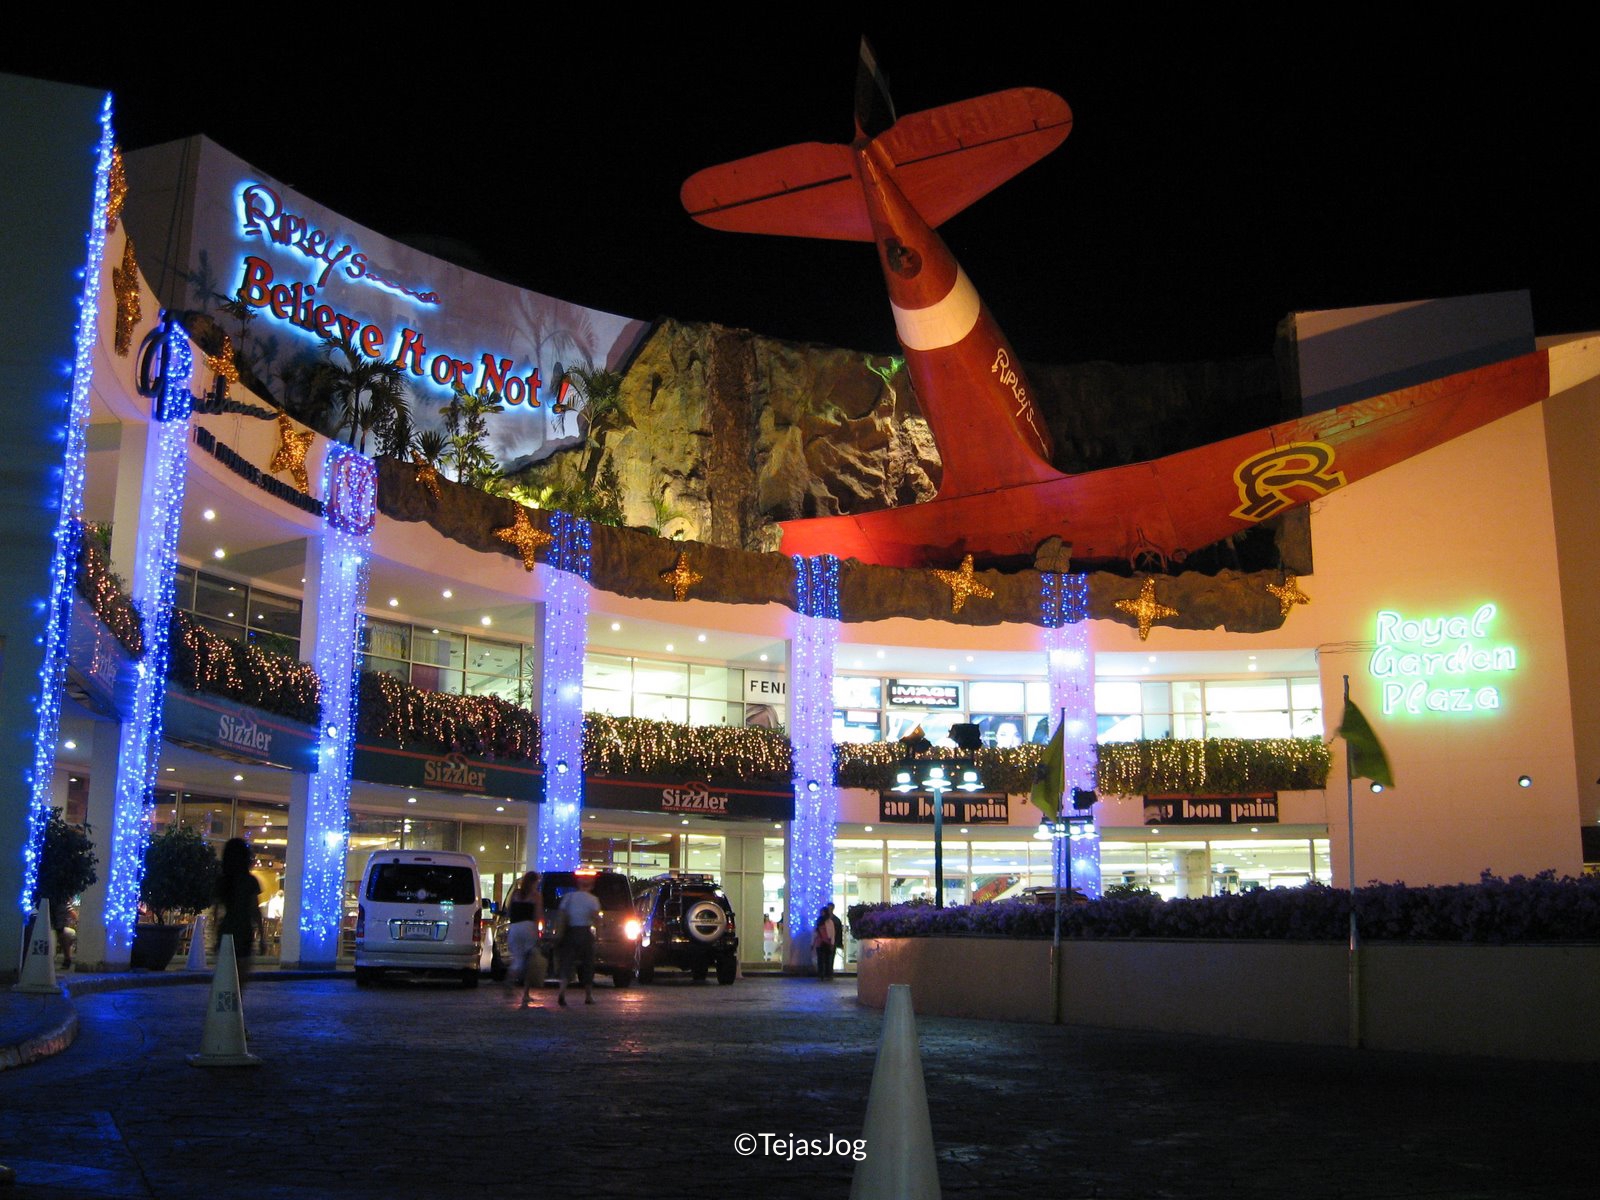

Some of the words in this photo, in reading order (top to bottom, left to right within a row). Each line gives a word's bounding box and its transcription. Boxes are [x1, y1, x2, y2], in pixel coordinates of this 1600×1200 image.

[236, 256, 385, 358] Believe
[395, 328, 426, 376] It
[430, 354, 473, 393] or
[1376, 603, 1497, 648] Royal
[1368, 642, 1517, 678] Garden
[891, 686, 957, 698] IMAGE
[1382, 680, 1500, 715] Plaza
[218, 713, 272, 752] Sizzler
[424, 759, 487, 786] Sizzler
[662, 788, 728, 810] Sizzler
[884, 801, 910, 816] au
[964, 798, 1007, 822] pain
[1182, 799, 1222, 818] bon
[1230, 798, 1275, 822] pain
